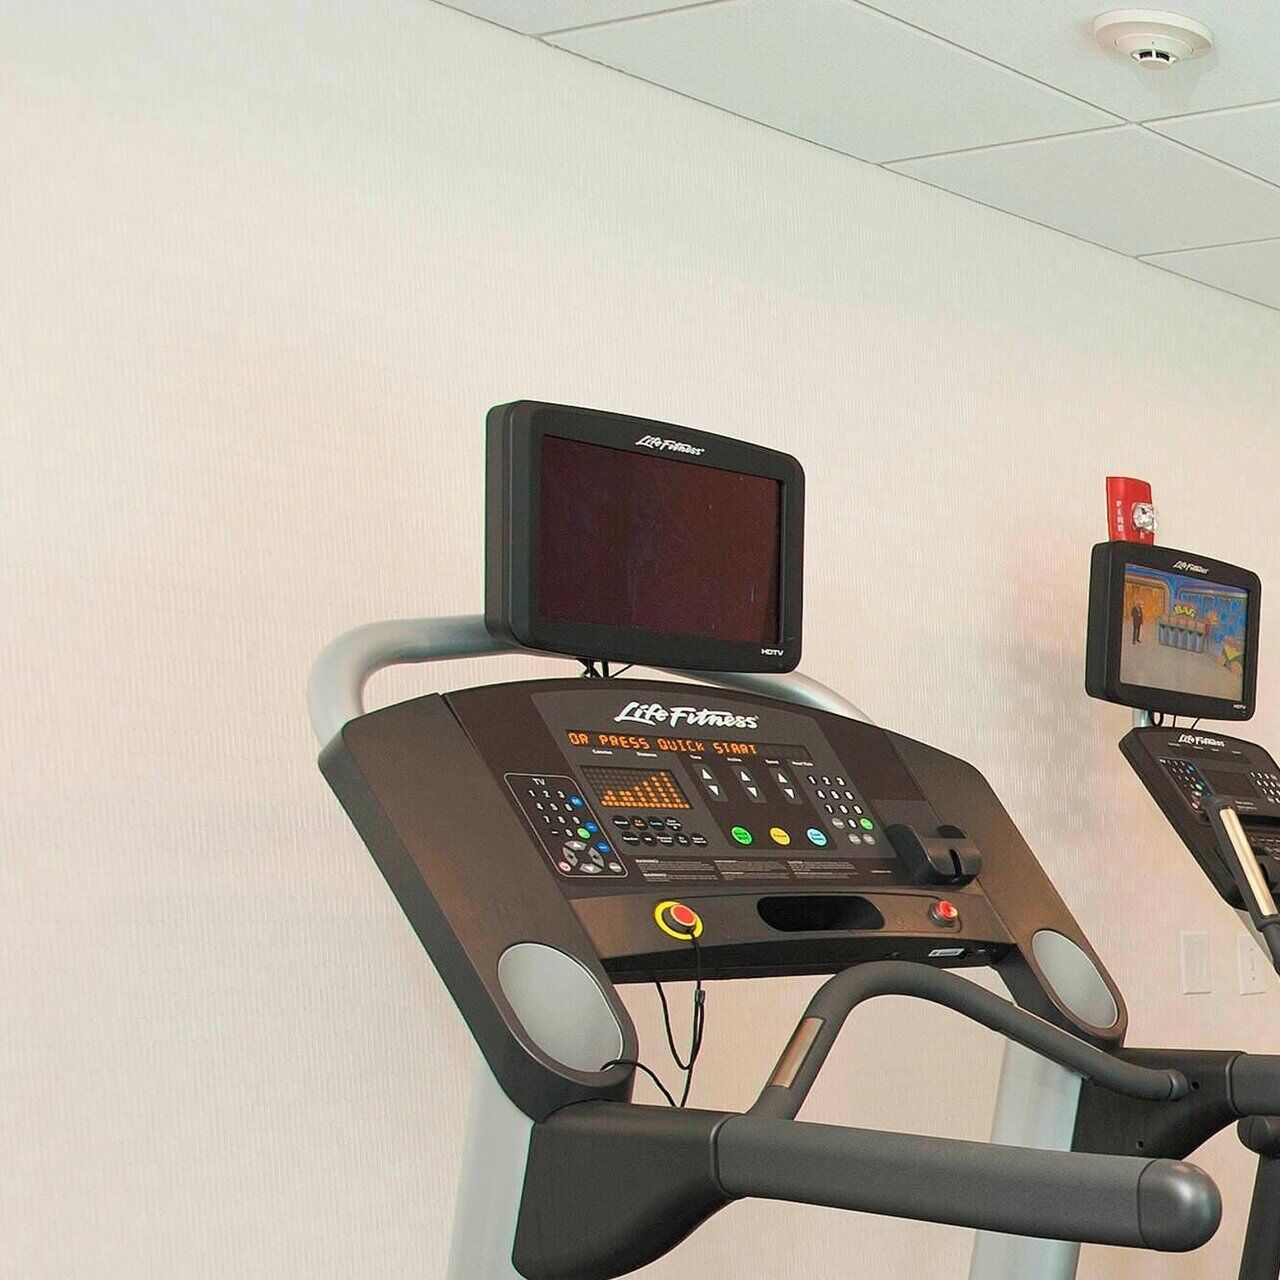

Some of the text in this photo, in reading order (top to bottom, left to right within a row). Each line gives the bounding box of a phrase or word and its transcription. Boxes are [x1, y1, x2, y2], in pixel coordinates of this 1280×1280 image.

[761, 647, 784, 656] HDTV
[614, 701, 759, 729] Life Fitness
[567, 732, 757, 755] OR PRESS QUICK START
